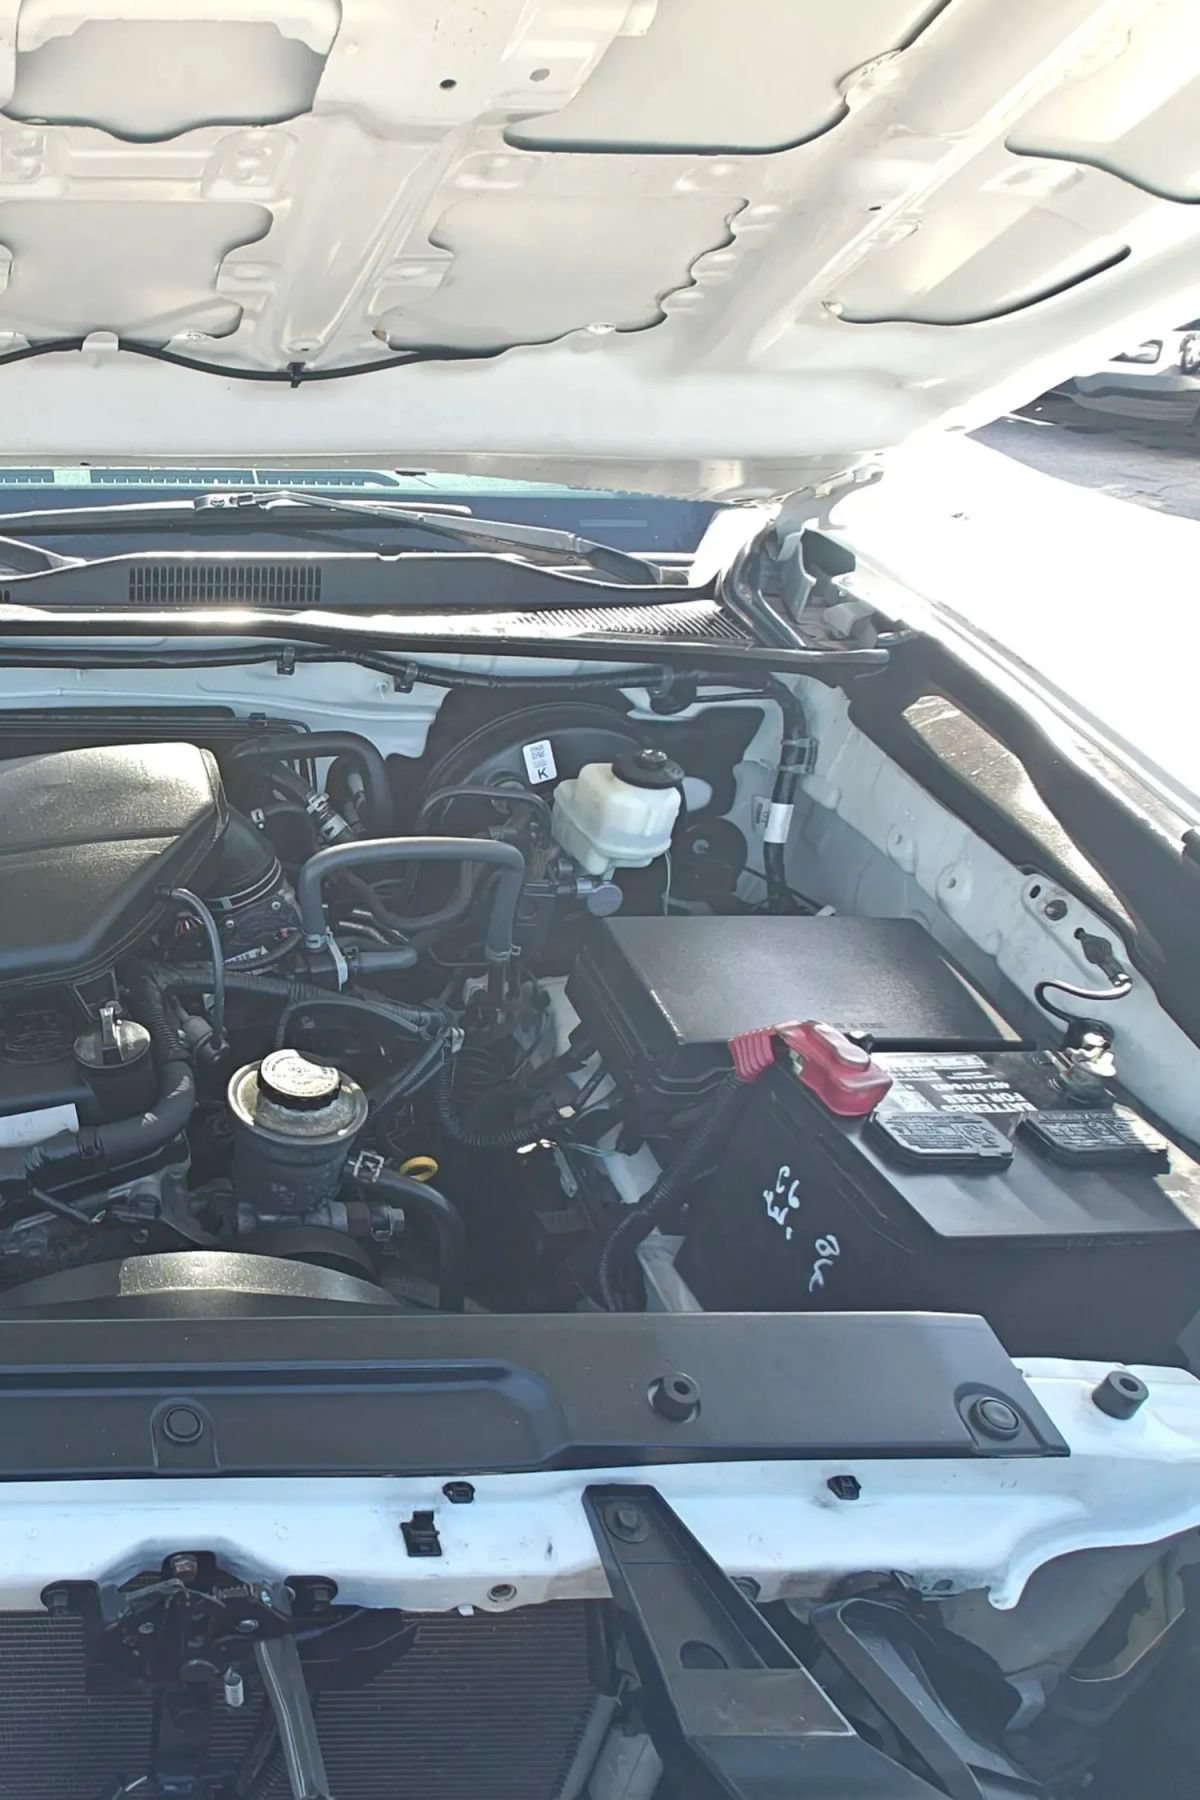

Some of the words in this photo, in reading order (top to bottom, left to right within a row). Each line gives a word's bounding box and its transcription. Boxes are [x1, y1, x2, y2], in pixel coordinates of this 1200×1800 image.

[537, 767, 549, 779] K
[941, 1094, 989, 1104] LESS
[985, 1092, 1028, 1102] FOR
[940, 1102, 1038, 1113] BATTERIES
